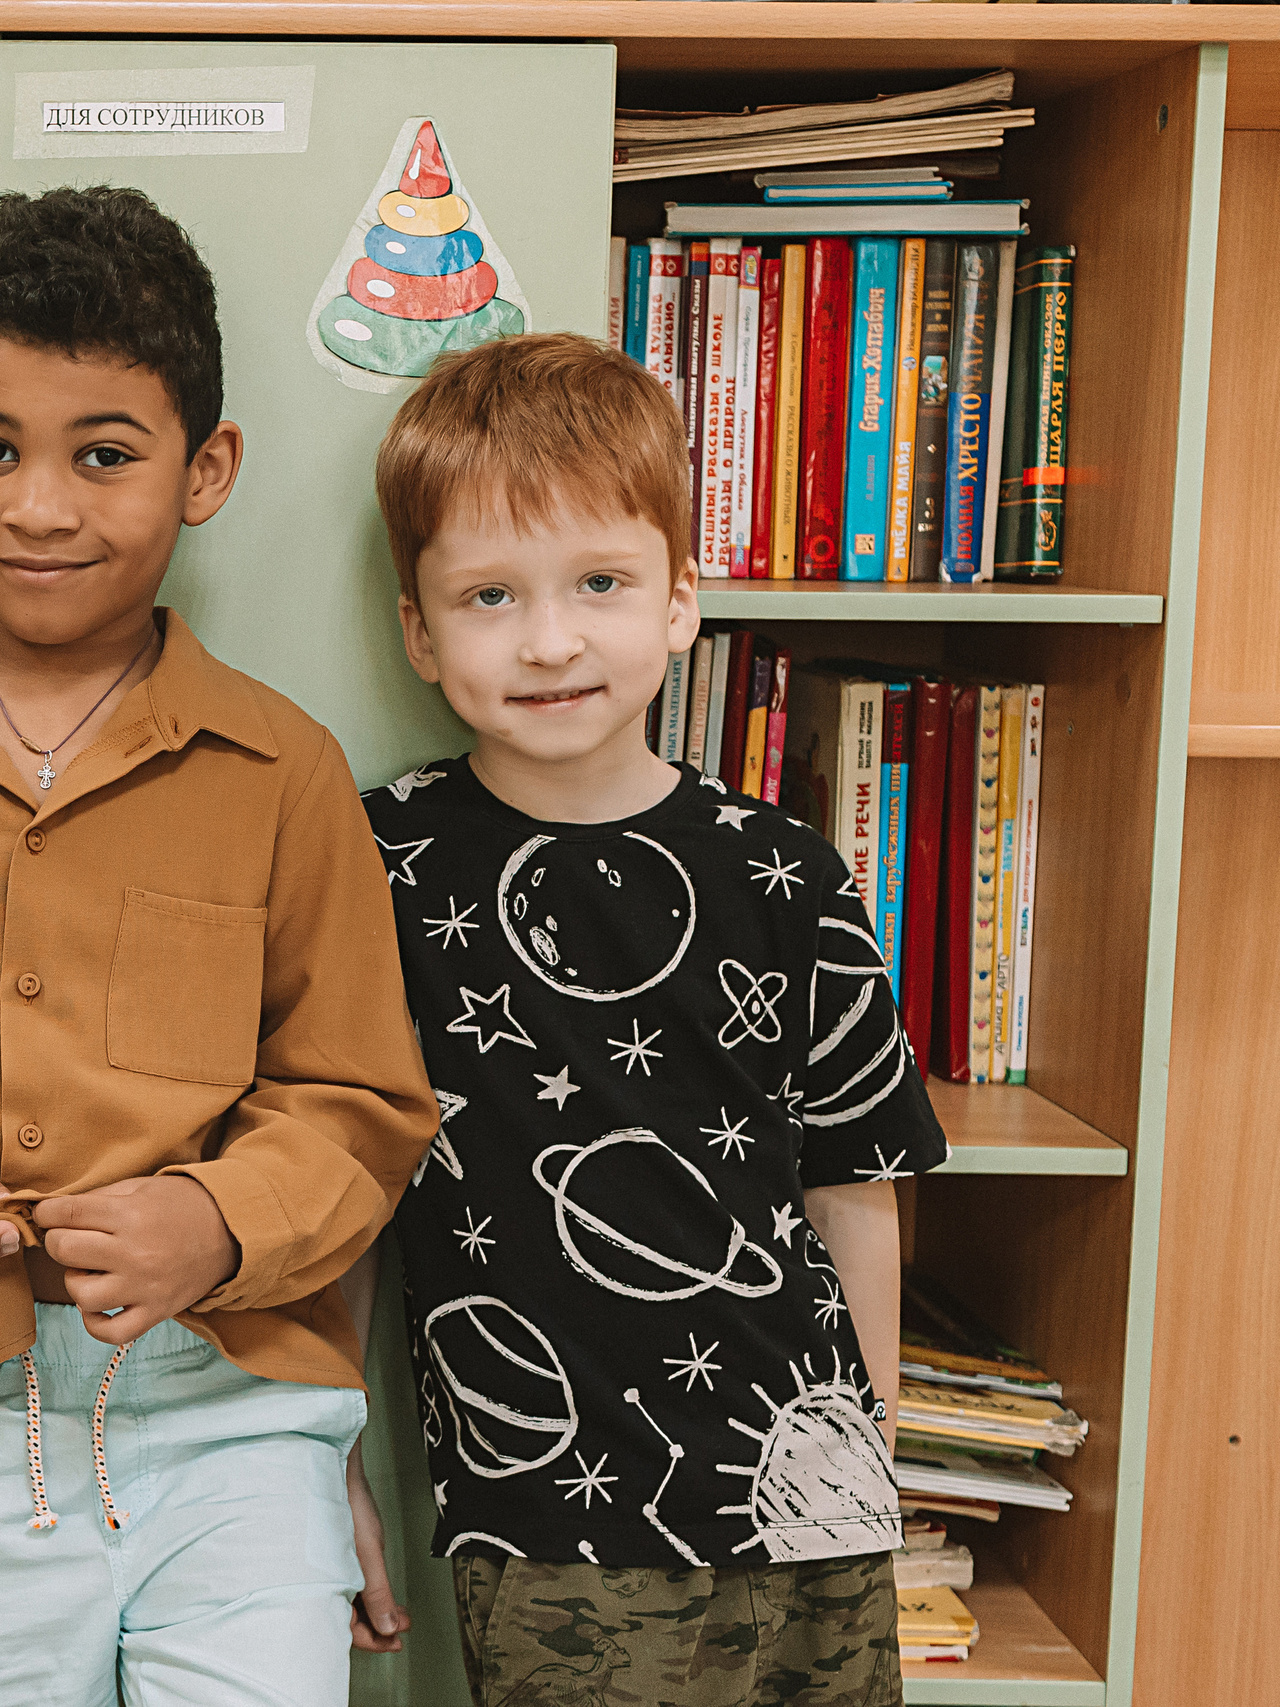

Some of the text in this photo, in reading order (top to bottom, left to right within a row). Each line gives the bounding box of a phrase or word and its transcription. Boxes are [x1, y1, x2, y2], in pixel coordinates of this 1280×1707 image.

[46, 108, 265, 129] ДЛЯ СОТРУДНИКОВ
[609, 297, 619, 346] АУГЛИ
[650, 293, 662, 353] КУЗЬКА
[691, 279, 700, 314] Сказы
[862, 286, 885, 370] Хоттабыч
[1044, 293, 1053, 348] СКАЗОК
[858, 372, 881, 432] Старик
[956, 312, 984, 481] ХРЕСТОМАТИЯ
[1042, 352, 1050, 396] КНИГА
[688, 379, 696, 447] Малахитовая
[703, 483, 716, 563] СМЕШНЫЕ
[710, 313, 722, 366] ШКОЛЕ
[723, 375, 735, 449] ПРИРОДЕ
[785, 405, 795, 453] РАССКАЗЫ
[1048, 381, 1062, 467] ШАРЛЯ
[782, 468, 792, 524] ЖИВОТНЫХ
[894, 441, 911, 490] МАЙЯ
[891, 495, 908, 558] ПЧЁЛКА
[956, 485, 973, 559] ПОЛНАЯ
[666, 659, 682, 758] МЫХ МАЛЕНЬКИХ
[690, 679, 706, 759] В ИСТОРИЮ
[890, 703, 903, 790] писателей
[855, 782, 870, 838] РЕЧИ
[883, 795, 901, 903] зарубежных
